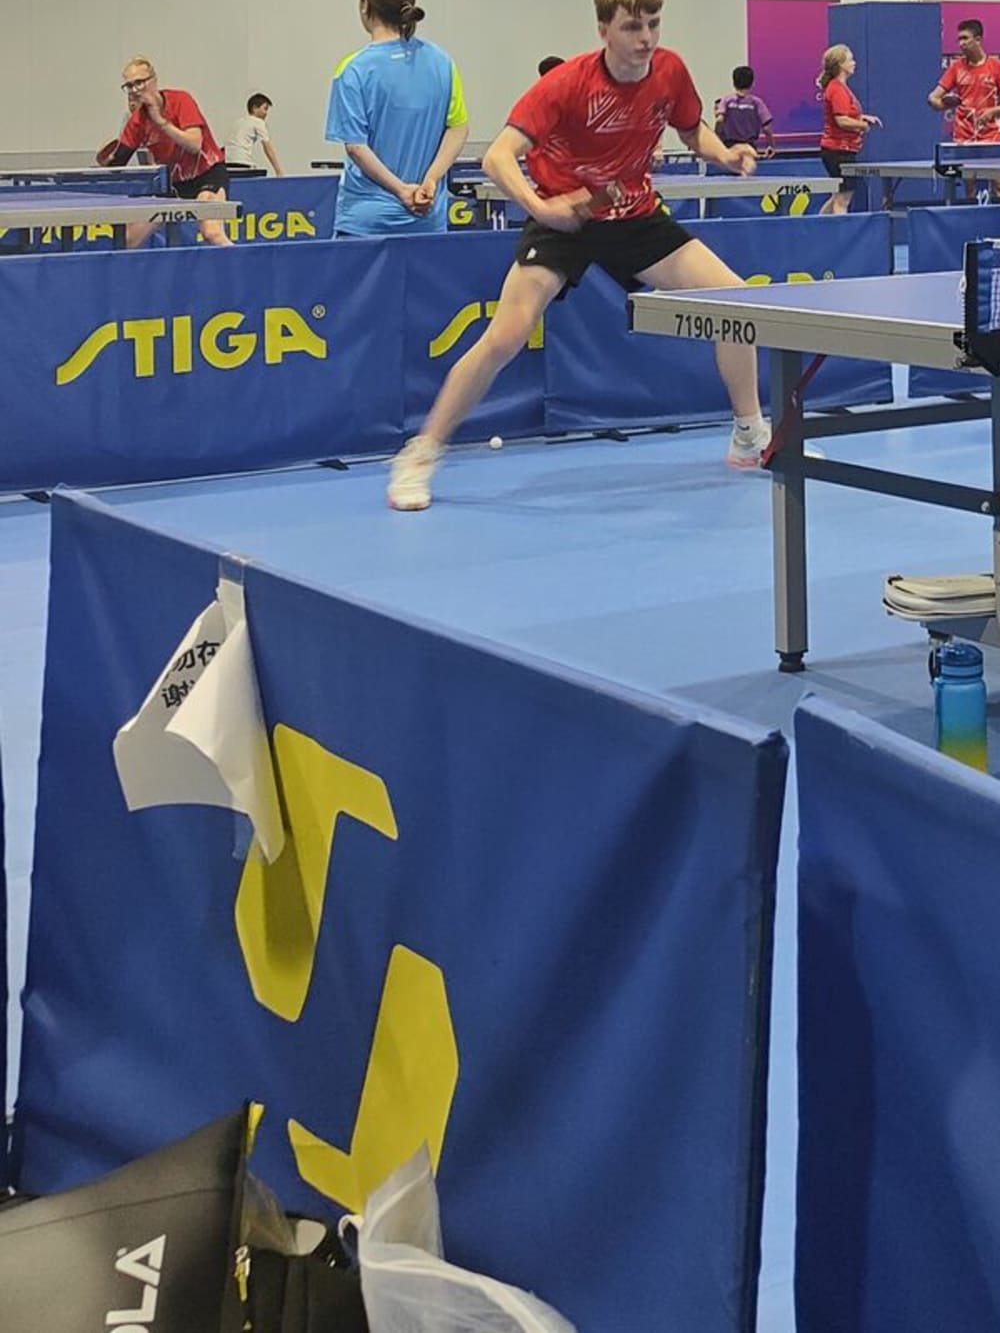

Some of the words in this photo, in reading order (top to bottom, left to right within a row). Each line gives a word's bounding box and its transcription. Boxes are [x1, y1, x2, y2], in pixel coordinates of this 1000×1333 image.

[149, 210, 199, 223] STIGA
[197, 210, 316, 243] TIGA
[674, 314, 757, 345] 7190-PRO
[55, 306, 328, 386] STIGA
